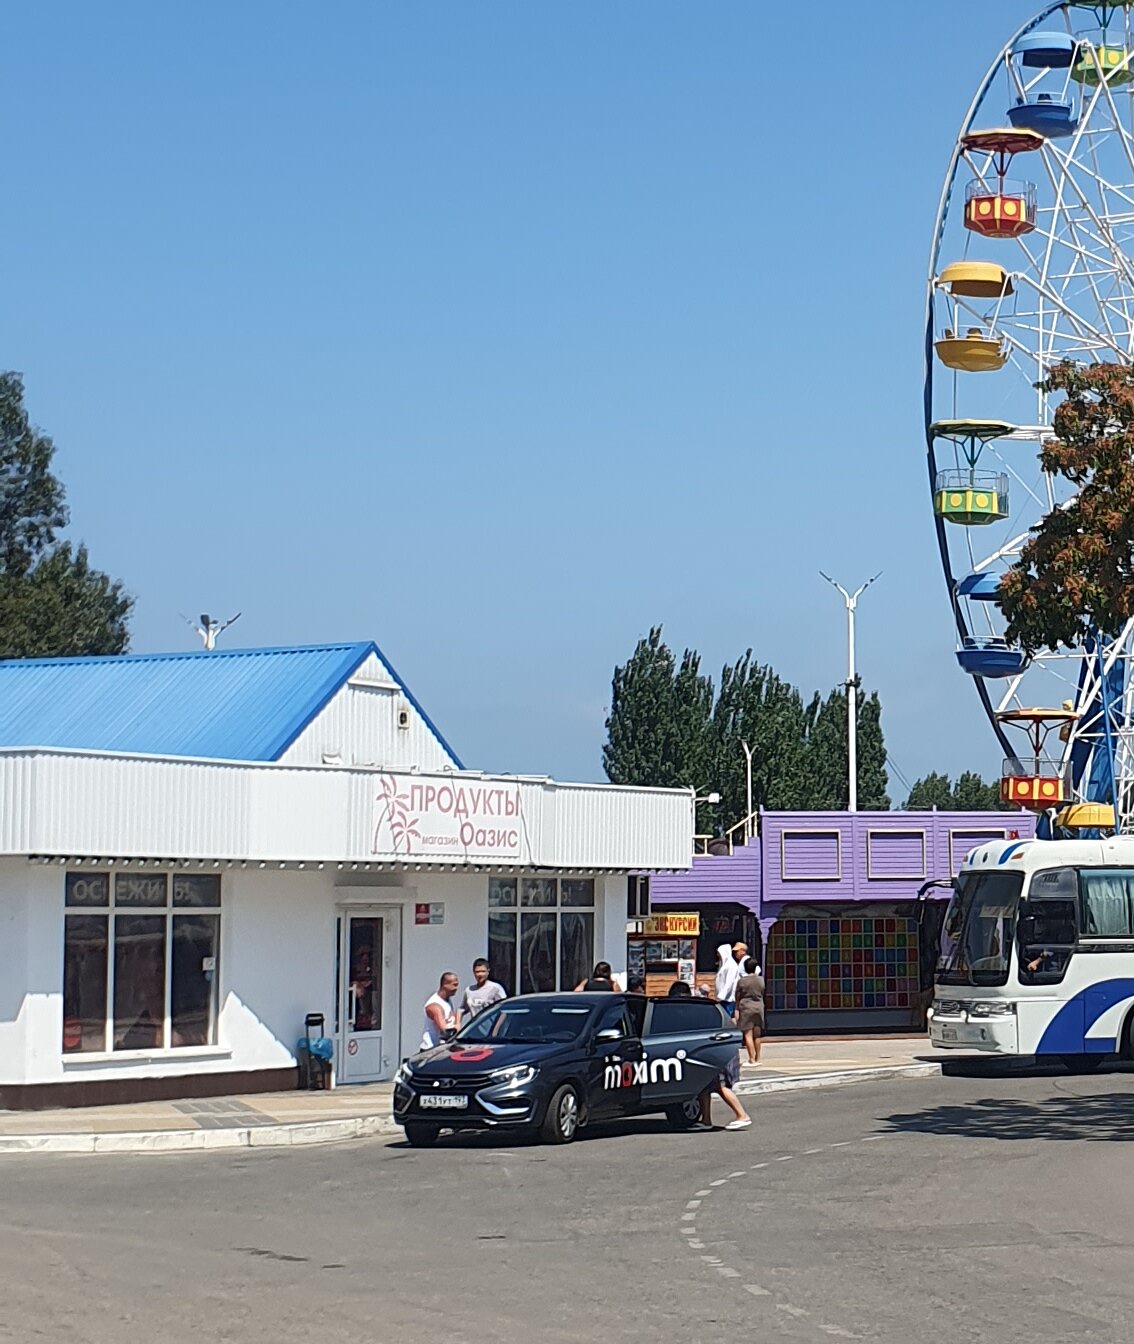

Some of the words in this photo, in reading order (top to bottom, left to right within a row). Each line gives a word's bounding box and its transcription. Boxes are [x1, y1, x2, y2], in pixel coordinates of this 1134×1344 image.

[411, 784, 520, 819] ПРОДУКТЫ
[421, 835, 459, 846] магазин
[460, 821, 519, 848] Оазис
[73, 880, 190, 901] ОСЕЖИЬ!
